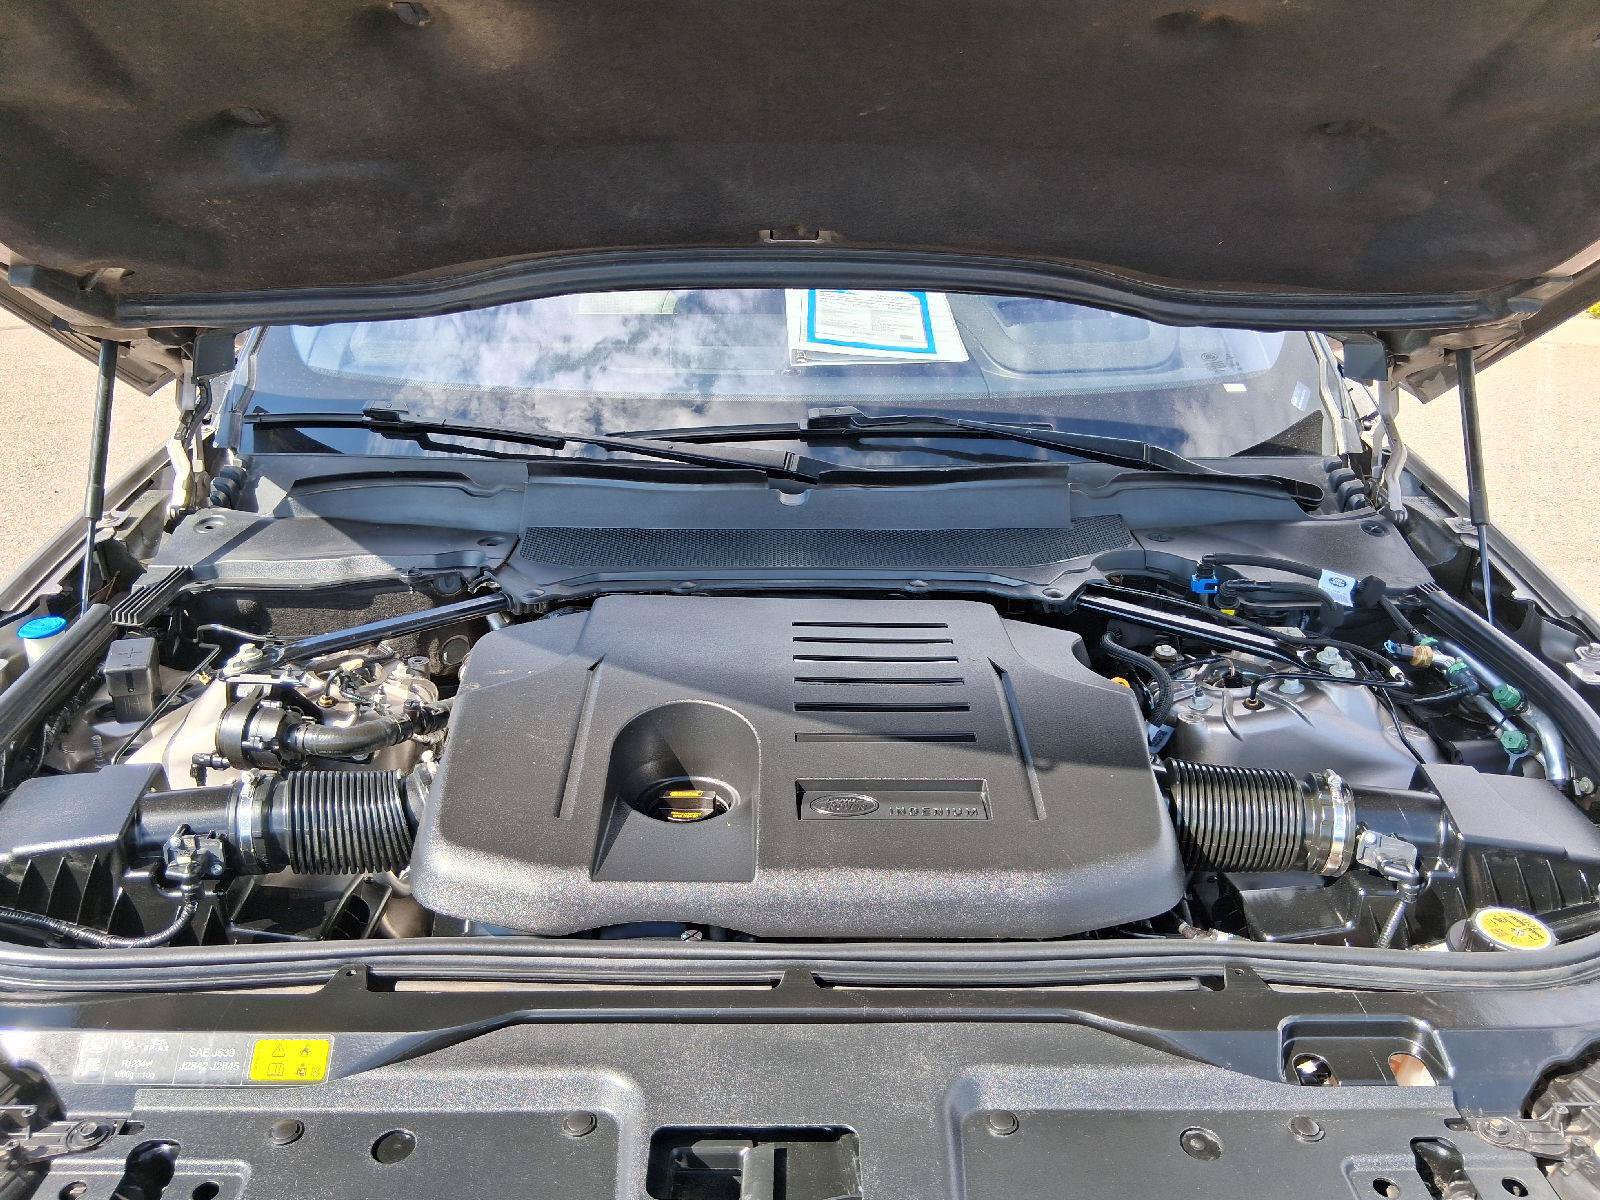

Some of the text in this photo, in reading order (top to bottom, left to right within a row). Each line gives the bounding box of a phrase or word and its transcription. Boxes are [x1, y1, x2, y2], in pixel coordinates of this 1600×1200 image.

[889, 807, 979, 816] INGENIUM
[190, 1047, 236, 1058] SAE J639
